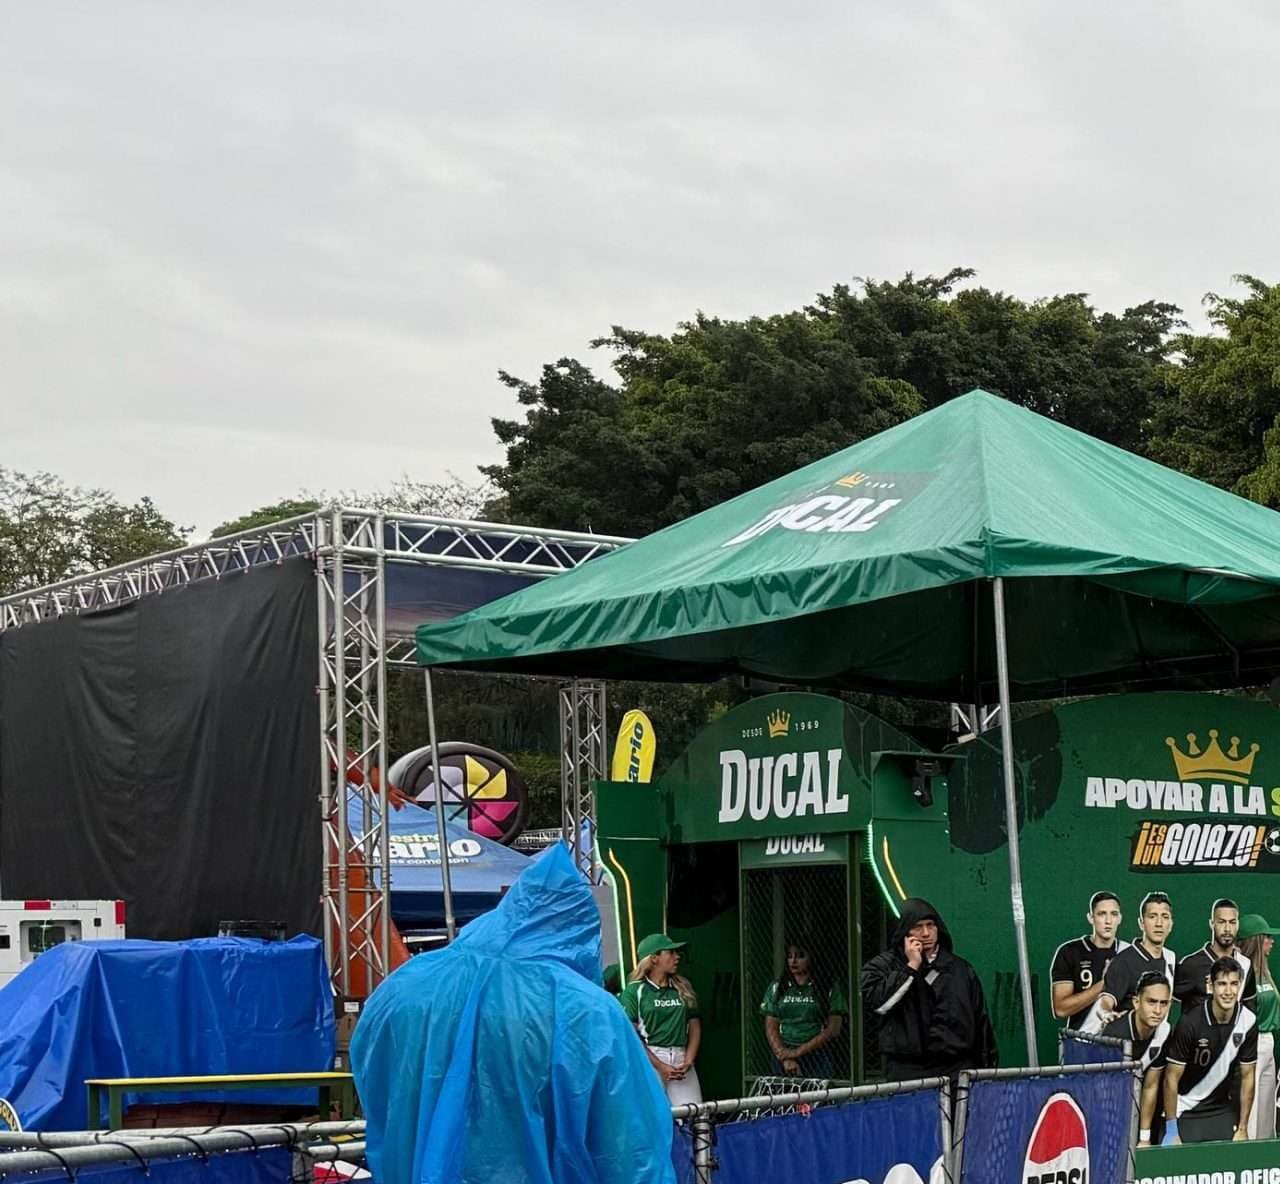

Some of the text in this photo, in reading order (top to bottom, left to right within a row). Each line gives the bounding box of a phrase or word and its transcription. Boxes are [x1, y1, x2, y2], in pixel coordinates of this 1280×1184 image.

[719, 748, 849, 823] DUCAL
[1085, 776, 1204, 812] APOYAR
[1209, 784, 1229, 814] A
[1233, 785, 1267, 816] LA
[1080, 969, 1093, 989] 9
